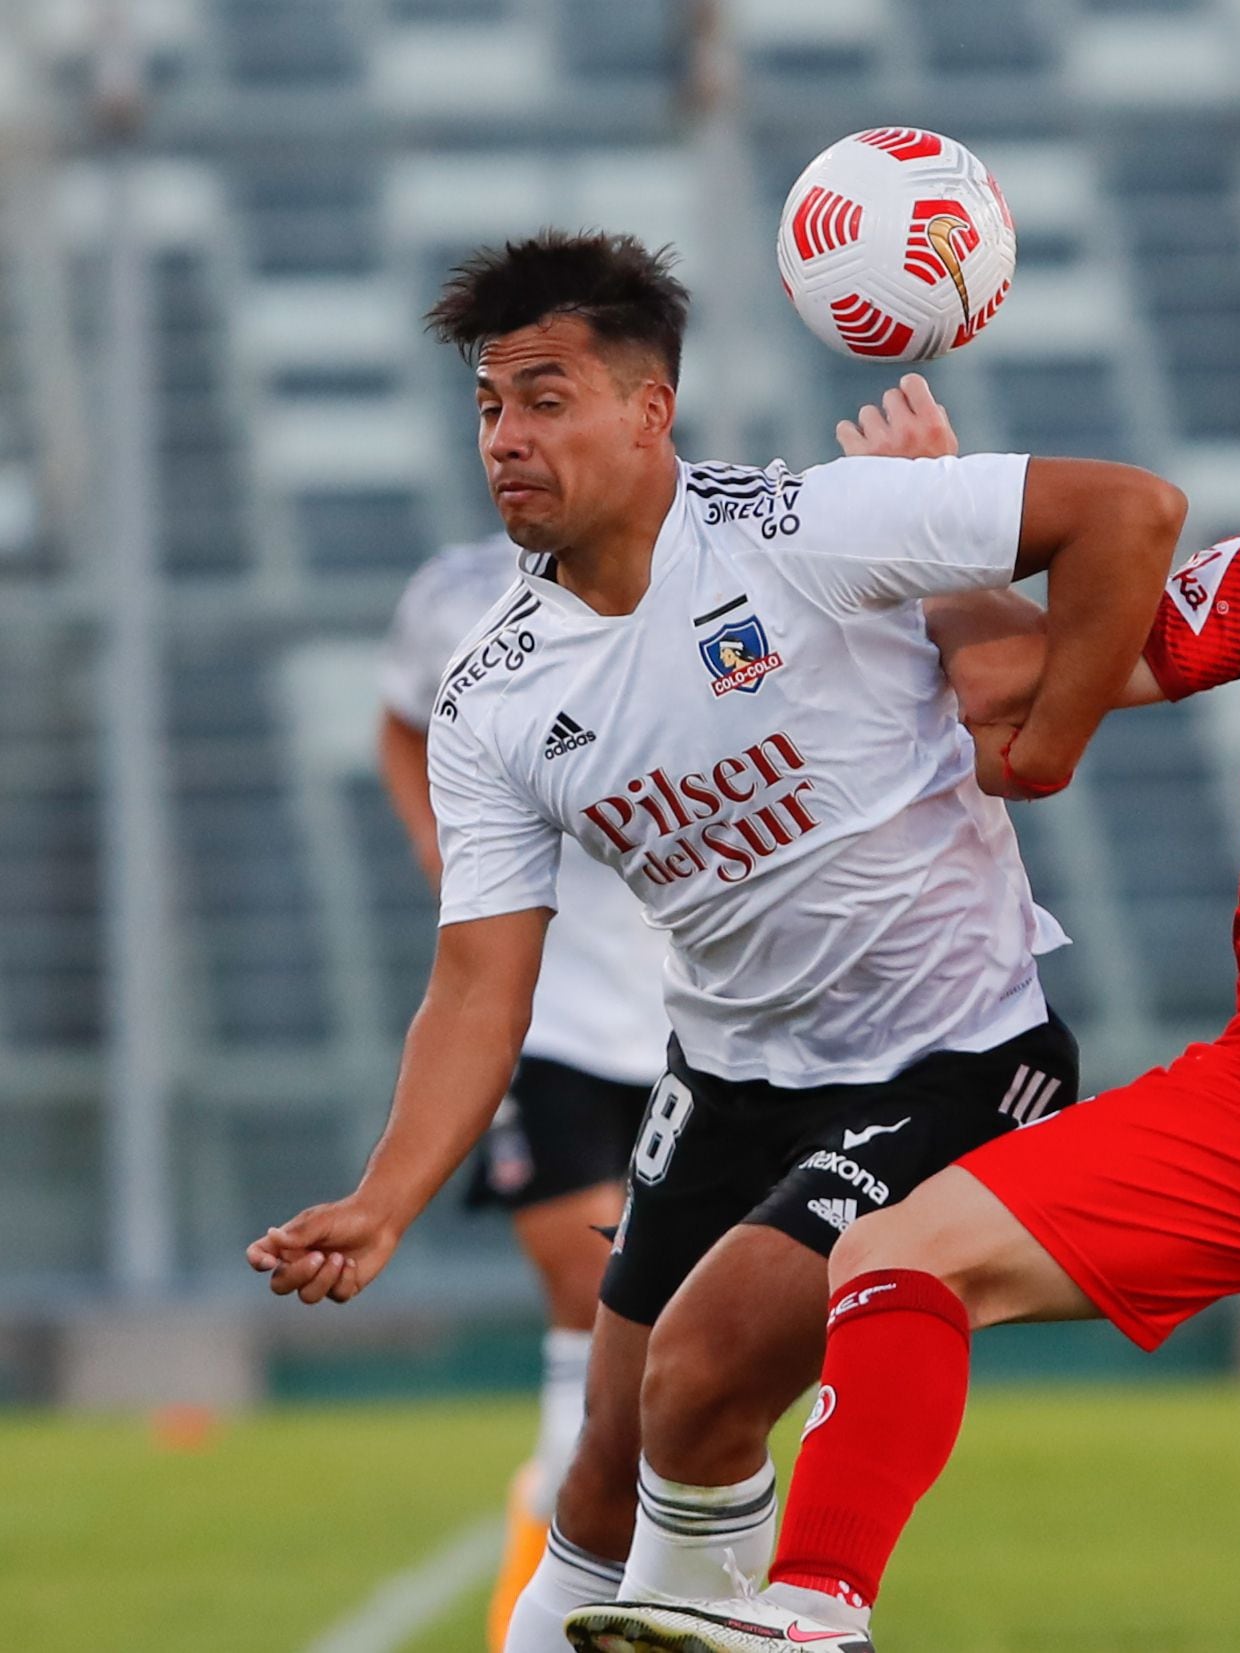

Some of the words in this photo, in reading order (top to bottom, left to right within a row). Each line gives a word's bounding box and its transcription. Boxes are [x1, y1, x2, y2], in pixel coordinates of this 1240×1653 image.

[703, 489, 800, 525] DIRECTV
[761, 514, 801, 540] GO
[505, 630, 536, 671] GO
[714, 655, 780, 693] COLO-COLO
[544, 729, 597, 761] adidas
[580, 731, 806, 854] Pilsen
[642, 837, 709, 885] del
[701, 779, 822, 883] Sur
[634, 1071, 694, 1186] 8
[799, 1149, 890, 1206] rexona
